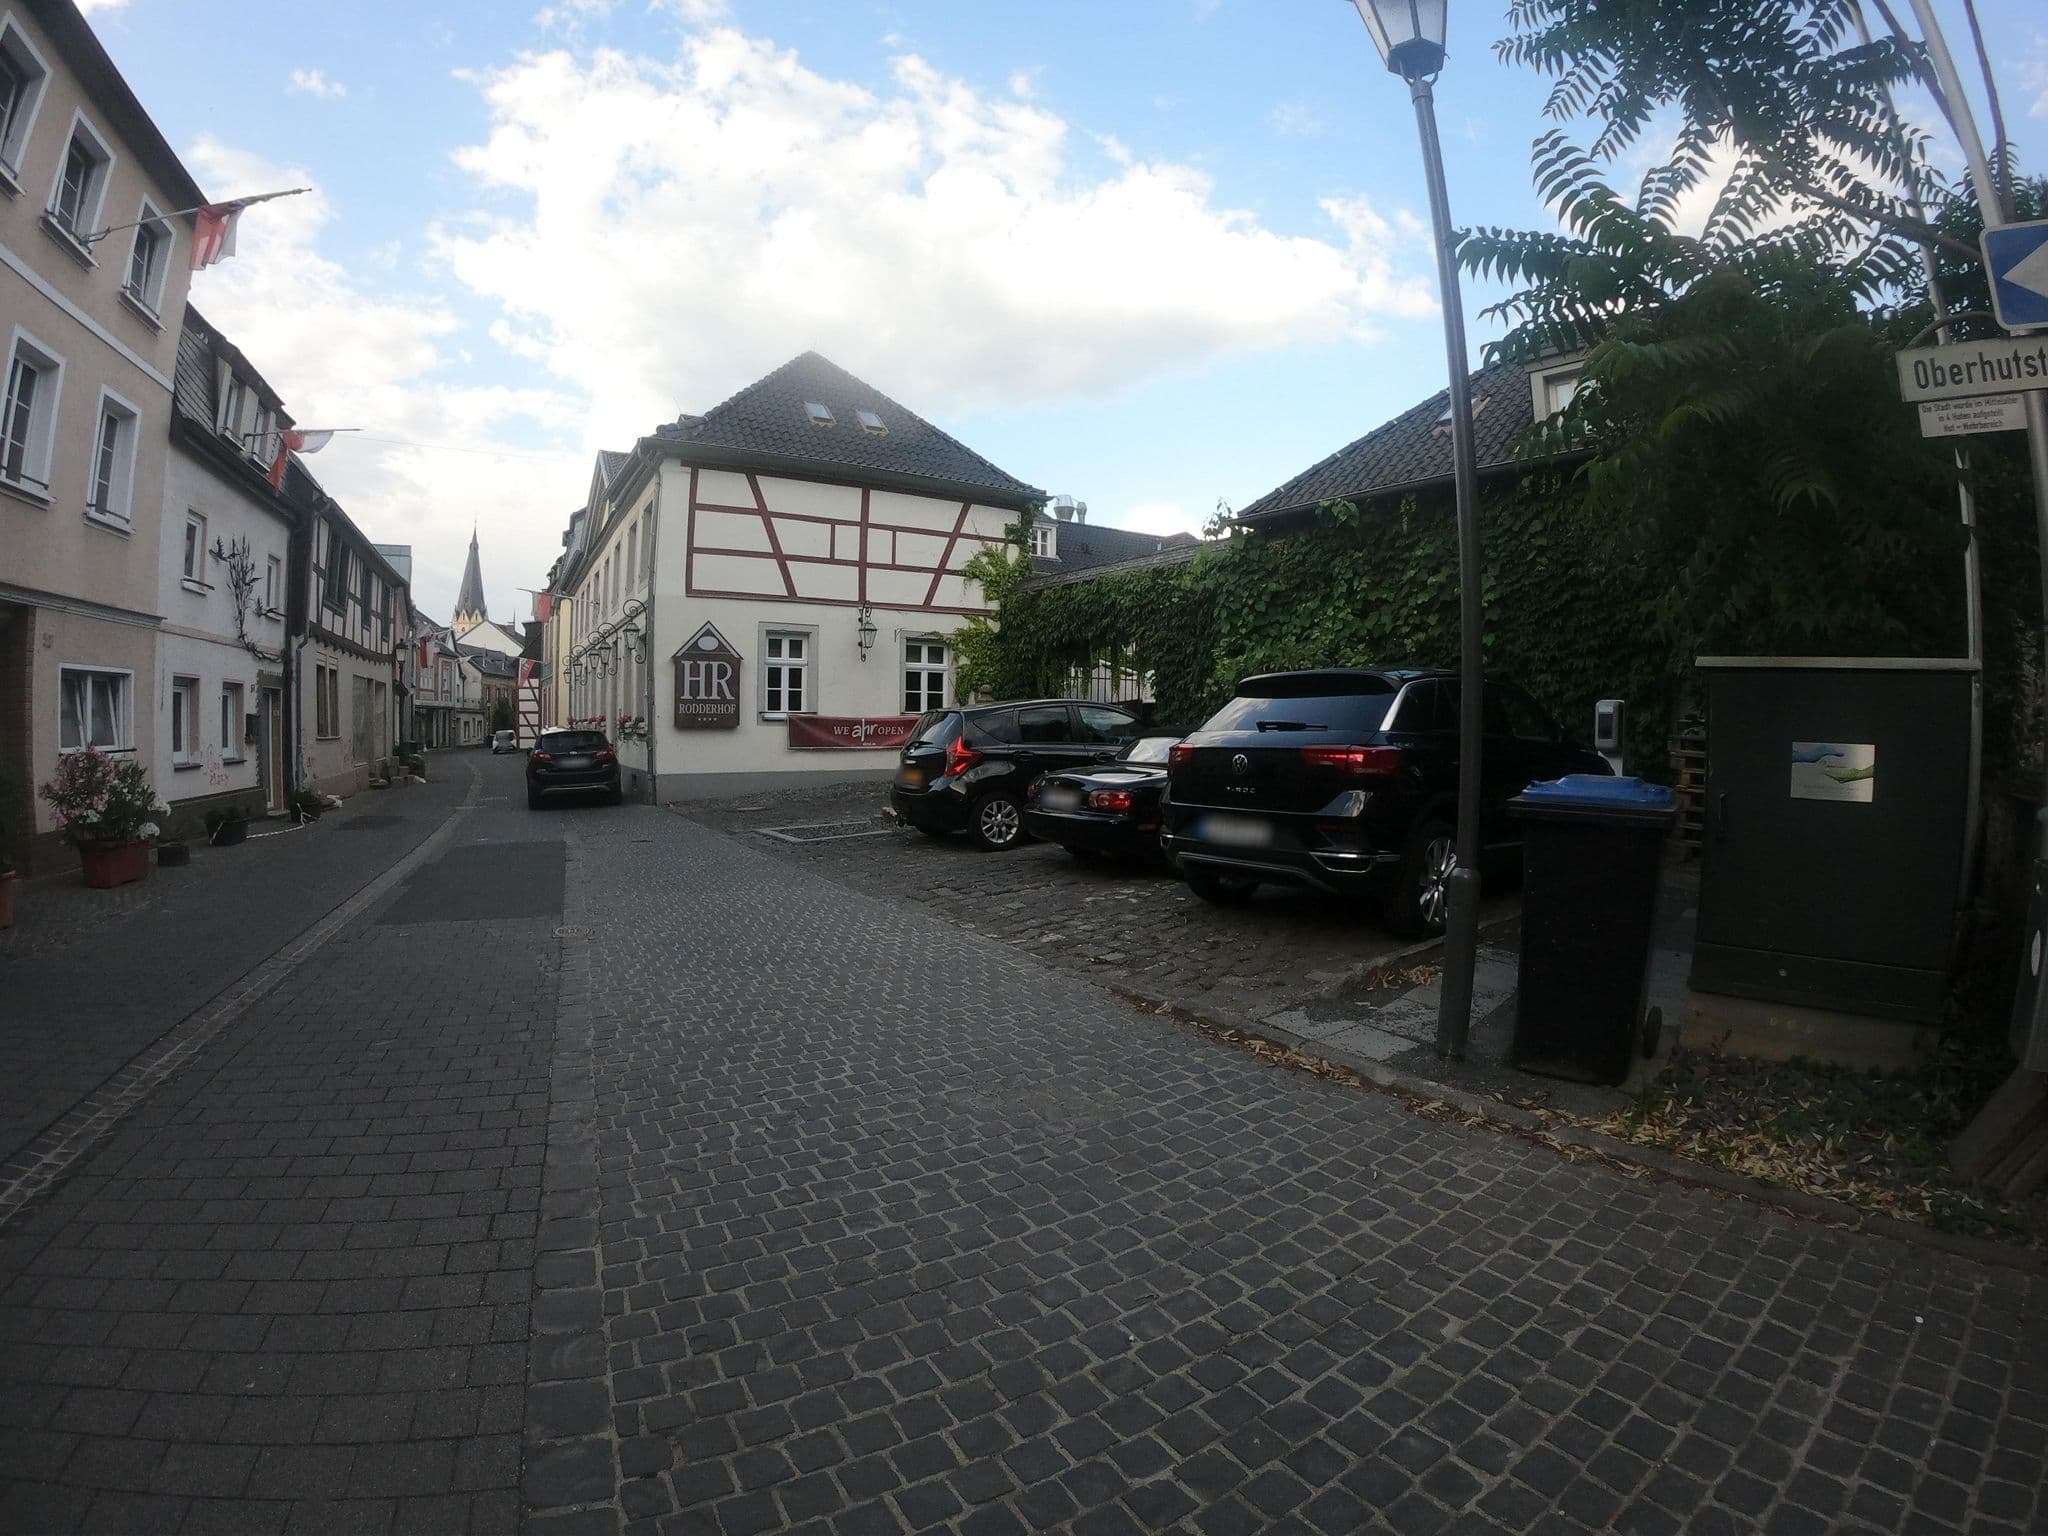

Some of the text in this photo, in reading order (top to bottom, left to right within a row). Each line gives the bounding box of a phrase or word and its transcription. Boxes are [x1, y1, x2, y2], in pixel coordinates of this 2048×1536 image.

[680, 660, 735, 699] HR
[679, 703, 737, 714] RODDERHOF
[833, 726, 850, 735] WE
[877, 726, 904, 735] OPEN
